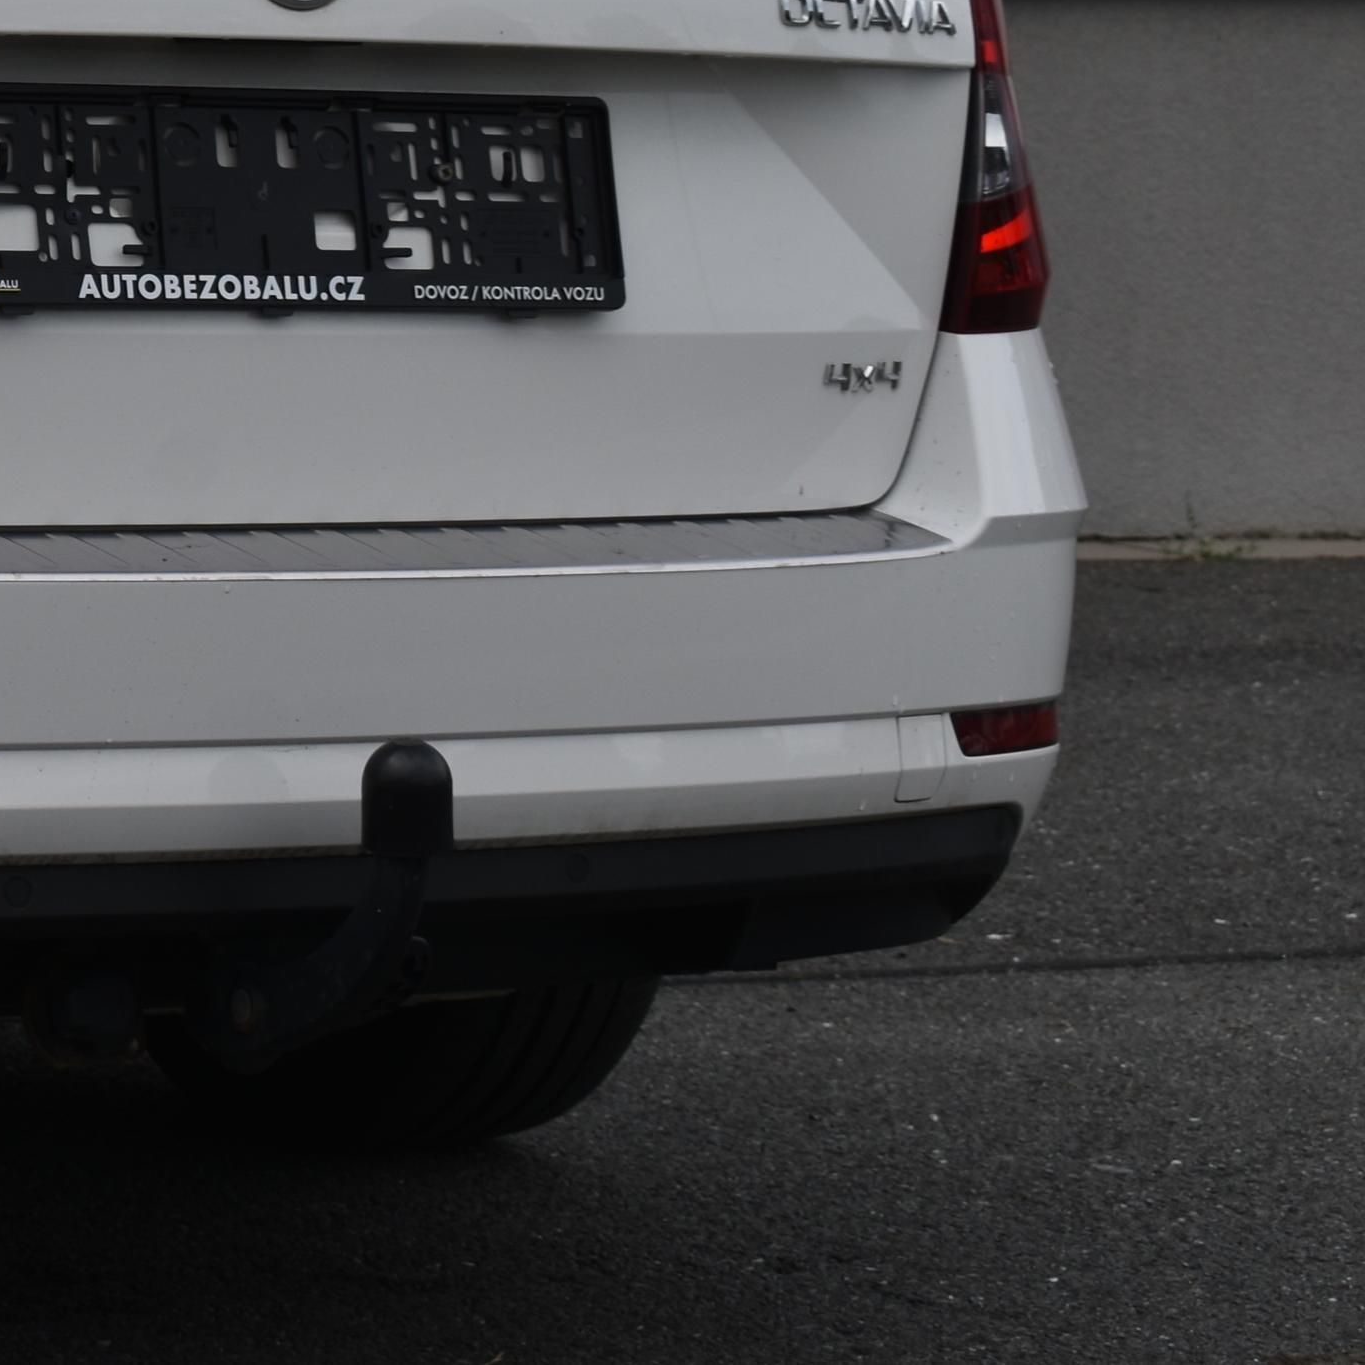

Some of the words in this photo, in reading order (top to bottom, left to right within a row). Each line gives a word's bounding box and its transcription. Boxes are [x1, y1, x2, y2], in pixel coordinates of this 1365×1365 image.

[78, 274, 366, 301] AUTOBEZOBALU.CZ
[414, 284, 469, 300] DOVOZ
[482, 286, 562, 301] KONTROLA
[563, 287, 605, 301] VOZU
